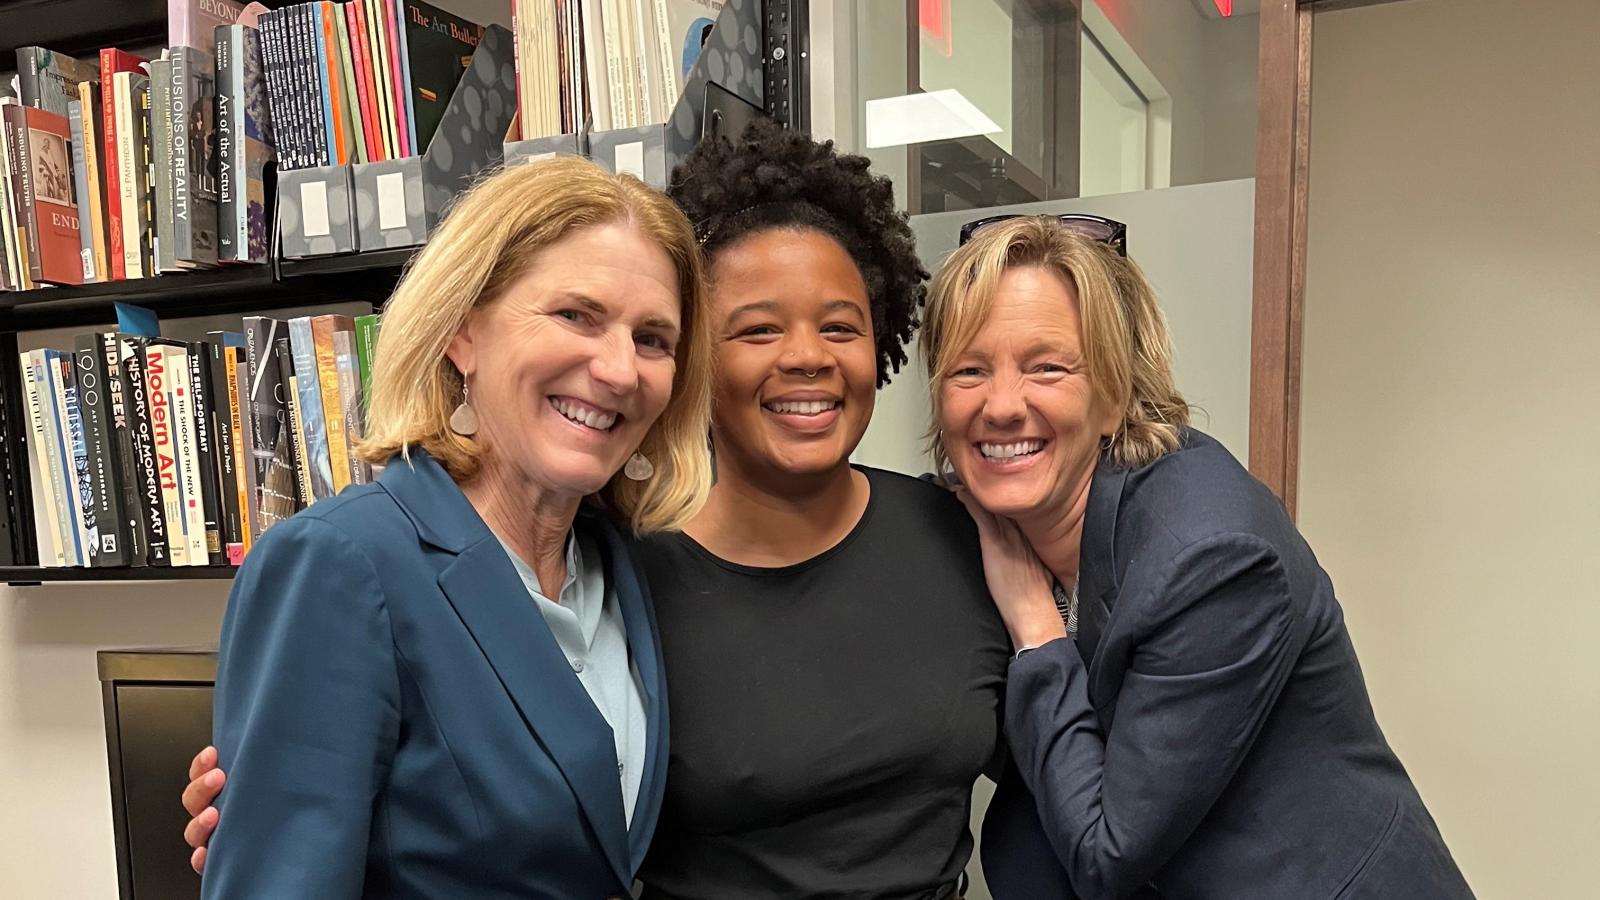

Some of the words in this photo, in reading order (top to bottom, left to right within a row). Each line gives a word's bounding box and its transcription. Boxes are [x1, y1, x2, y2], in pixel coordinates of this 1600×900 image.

[409, 5, 430, 28] The
[432, 16, 448, 36] Art
[449, 22, 480, 47] Bullet
[172, 52, 185, 133] ILLUSIONS
[219, 94, 229, 116] Art
[220, 119, 231, 133] of
[17, 127, 29, 172] ENDURING
[174, 136, 186, 154] OF
[220, 137, 230, 156] the
[21, 173, 31, 207] TRUTHS
[125, 188, 132, 198] LE
[175, 157, 188, 221] REALITY
[198, 173, 218, 194] ILL
[220, 161, 232, 203] Actual
[51, 212, 80, 230] END
[191, 354, 200, 374] THE
[247, 328, 257, 376] CRUZAMENTOS
[103, 332, 126, 429] HIDE/SEEK
[127, 357, 147, 420] HISTORY
[228, 374, 239, 406] RHAPSODIES
[146, 352, 170, 448] Modern
[193, 376, 208, 453] SELF-PORTRAIT
[77, 348, 98, 406] 1900
[94, 427, 99, 437] AT
[97, 457, 108, 511] CROSSROADS
[139, 422, 149, 442] OF
[180, 416, 188, 445] SHOCK
[221, 423, 230, 434] Art
[232, 414, 241, 430] BLACK
[183, 446, 190, 458] OF
[221, 434, 230, 444] for
[223, 445, 231, 455] the
[287, 400, 294, 408] LE
[291, 434, 300, 462] BONNAT
[297, 470, 307, 503] BAYONNE
[142, 444, 158, 505] MODERN
[155, 453, 177, 490] Art
[223, 455, 233, 474] People
[150, 507, 164, 537] ART
